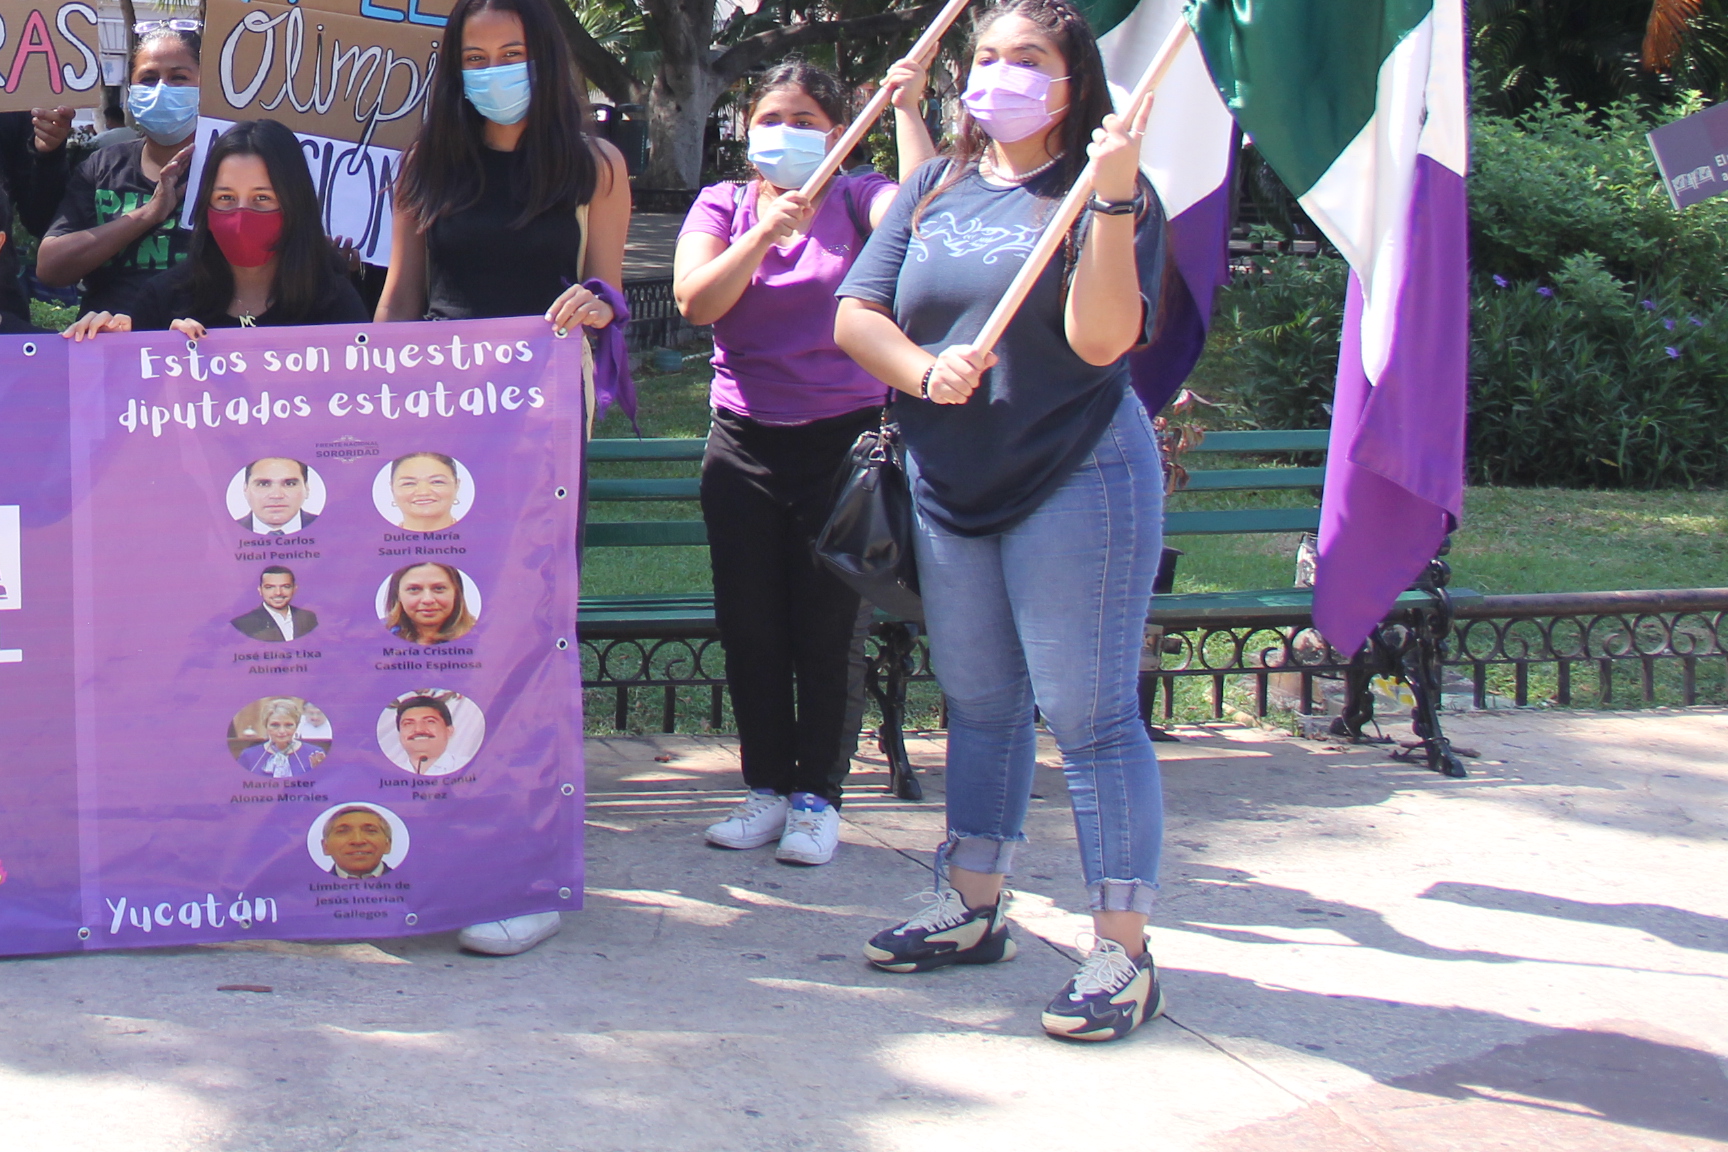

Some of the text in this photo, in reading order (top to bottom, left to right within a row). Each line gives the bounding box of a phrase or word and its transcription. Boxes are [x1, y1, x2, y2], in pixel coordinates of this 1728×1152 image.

[219, 6, 440, 175] Olimpi
[140, 334, 534, 382] Estos son nuestros
[119, 380, 545, 438] diputados estatales
[315, 448, 380, 458] SORORIDAD
[275, 536, 316, 546] Carlos
[383, 532, 420, 542] Dulce
[234, 550, 321, 561] Vidal Peniche
[378, 545, 467, 556] Sauri Riancho
[423, 645, 474, 656] Cristina
[374, 660, 482, 672] Castillo Espinosa
[283, 779, 316, 788] Ester
[379, 777, 409, 789] Juan
[277, 793, 329, 802] Morales
[394, 880, 411, 890] de
[105, 891, 279, 935] Yucatán
